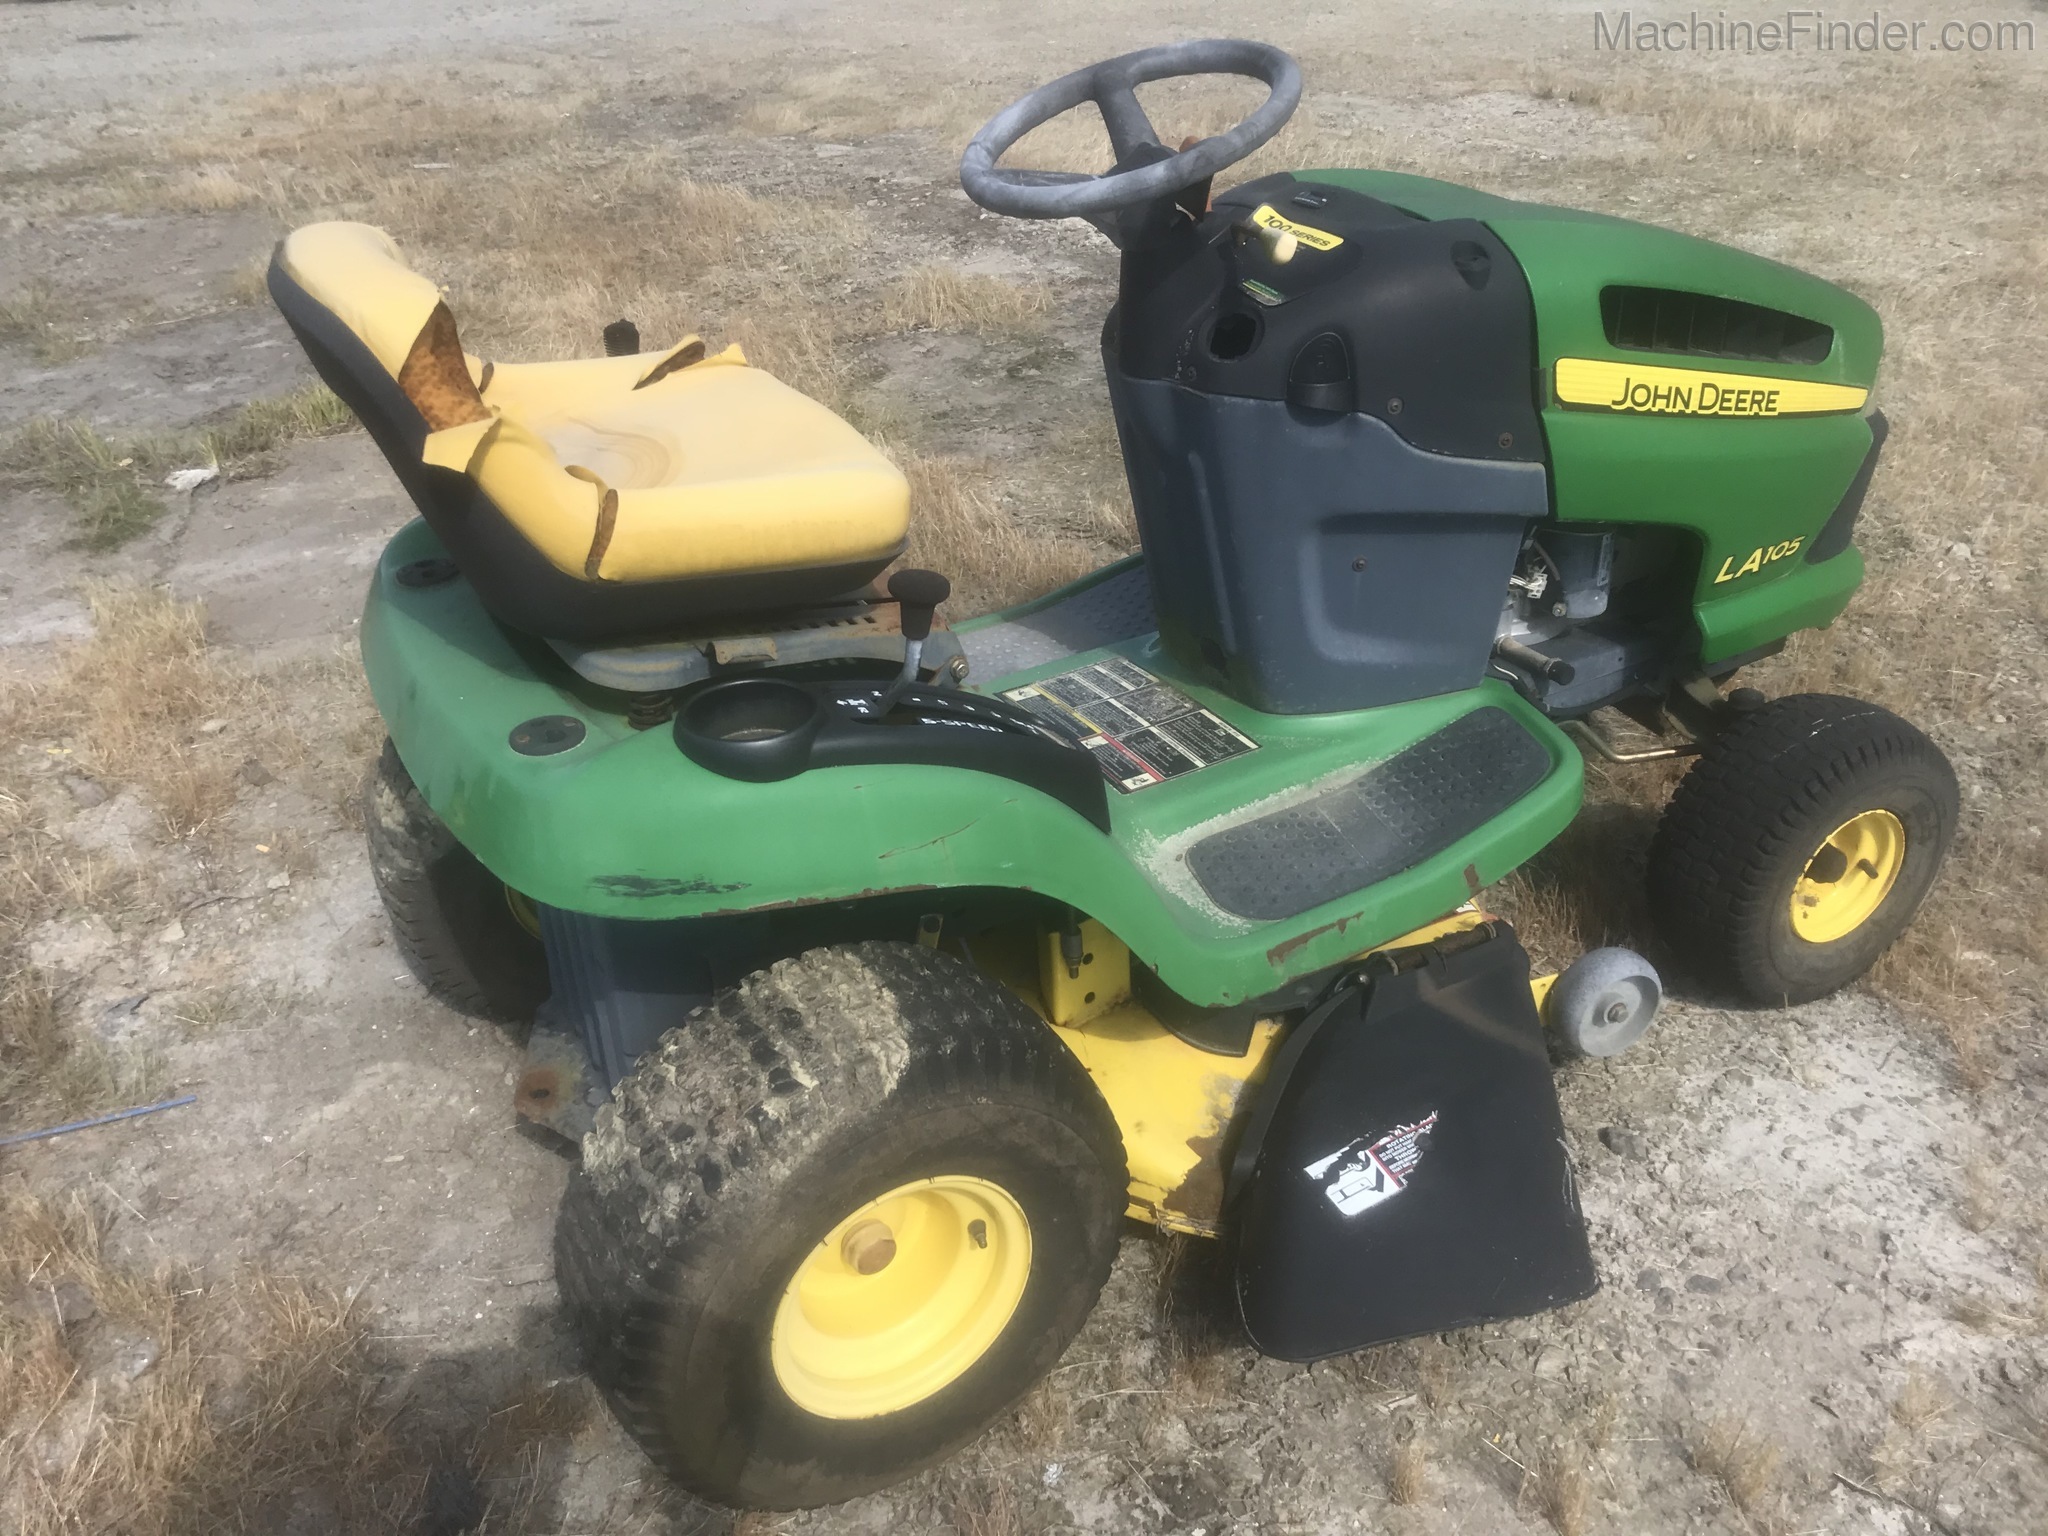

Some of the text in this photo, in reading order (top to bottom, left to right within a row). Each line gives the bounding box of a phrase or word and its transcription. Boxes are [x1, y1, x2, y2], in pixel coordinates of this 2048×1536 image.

[1289, 229, 1331, 247] SERIES
[1611, 377, 1781, 413] JOHN DEERE
[1713, 535, 1807, 585] LA105
